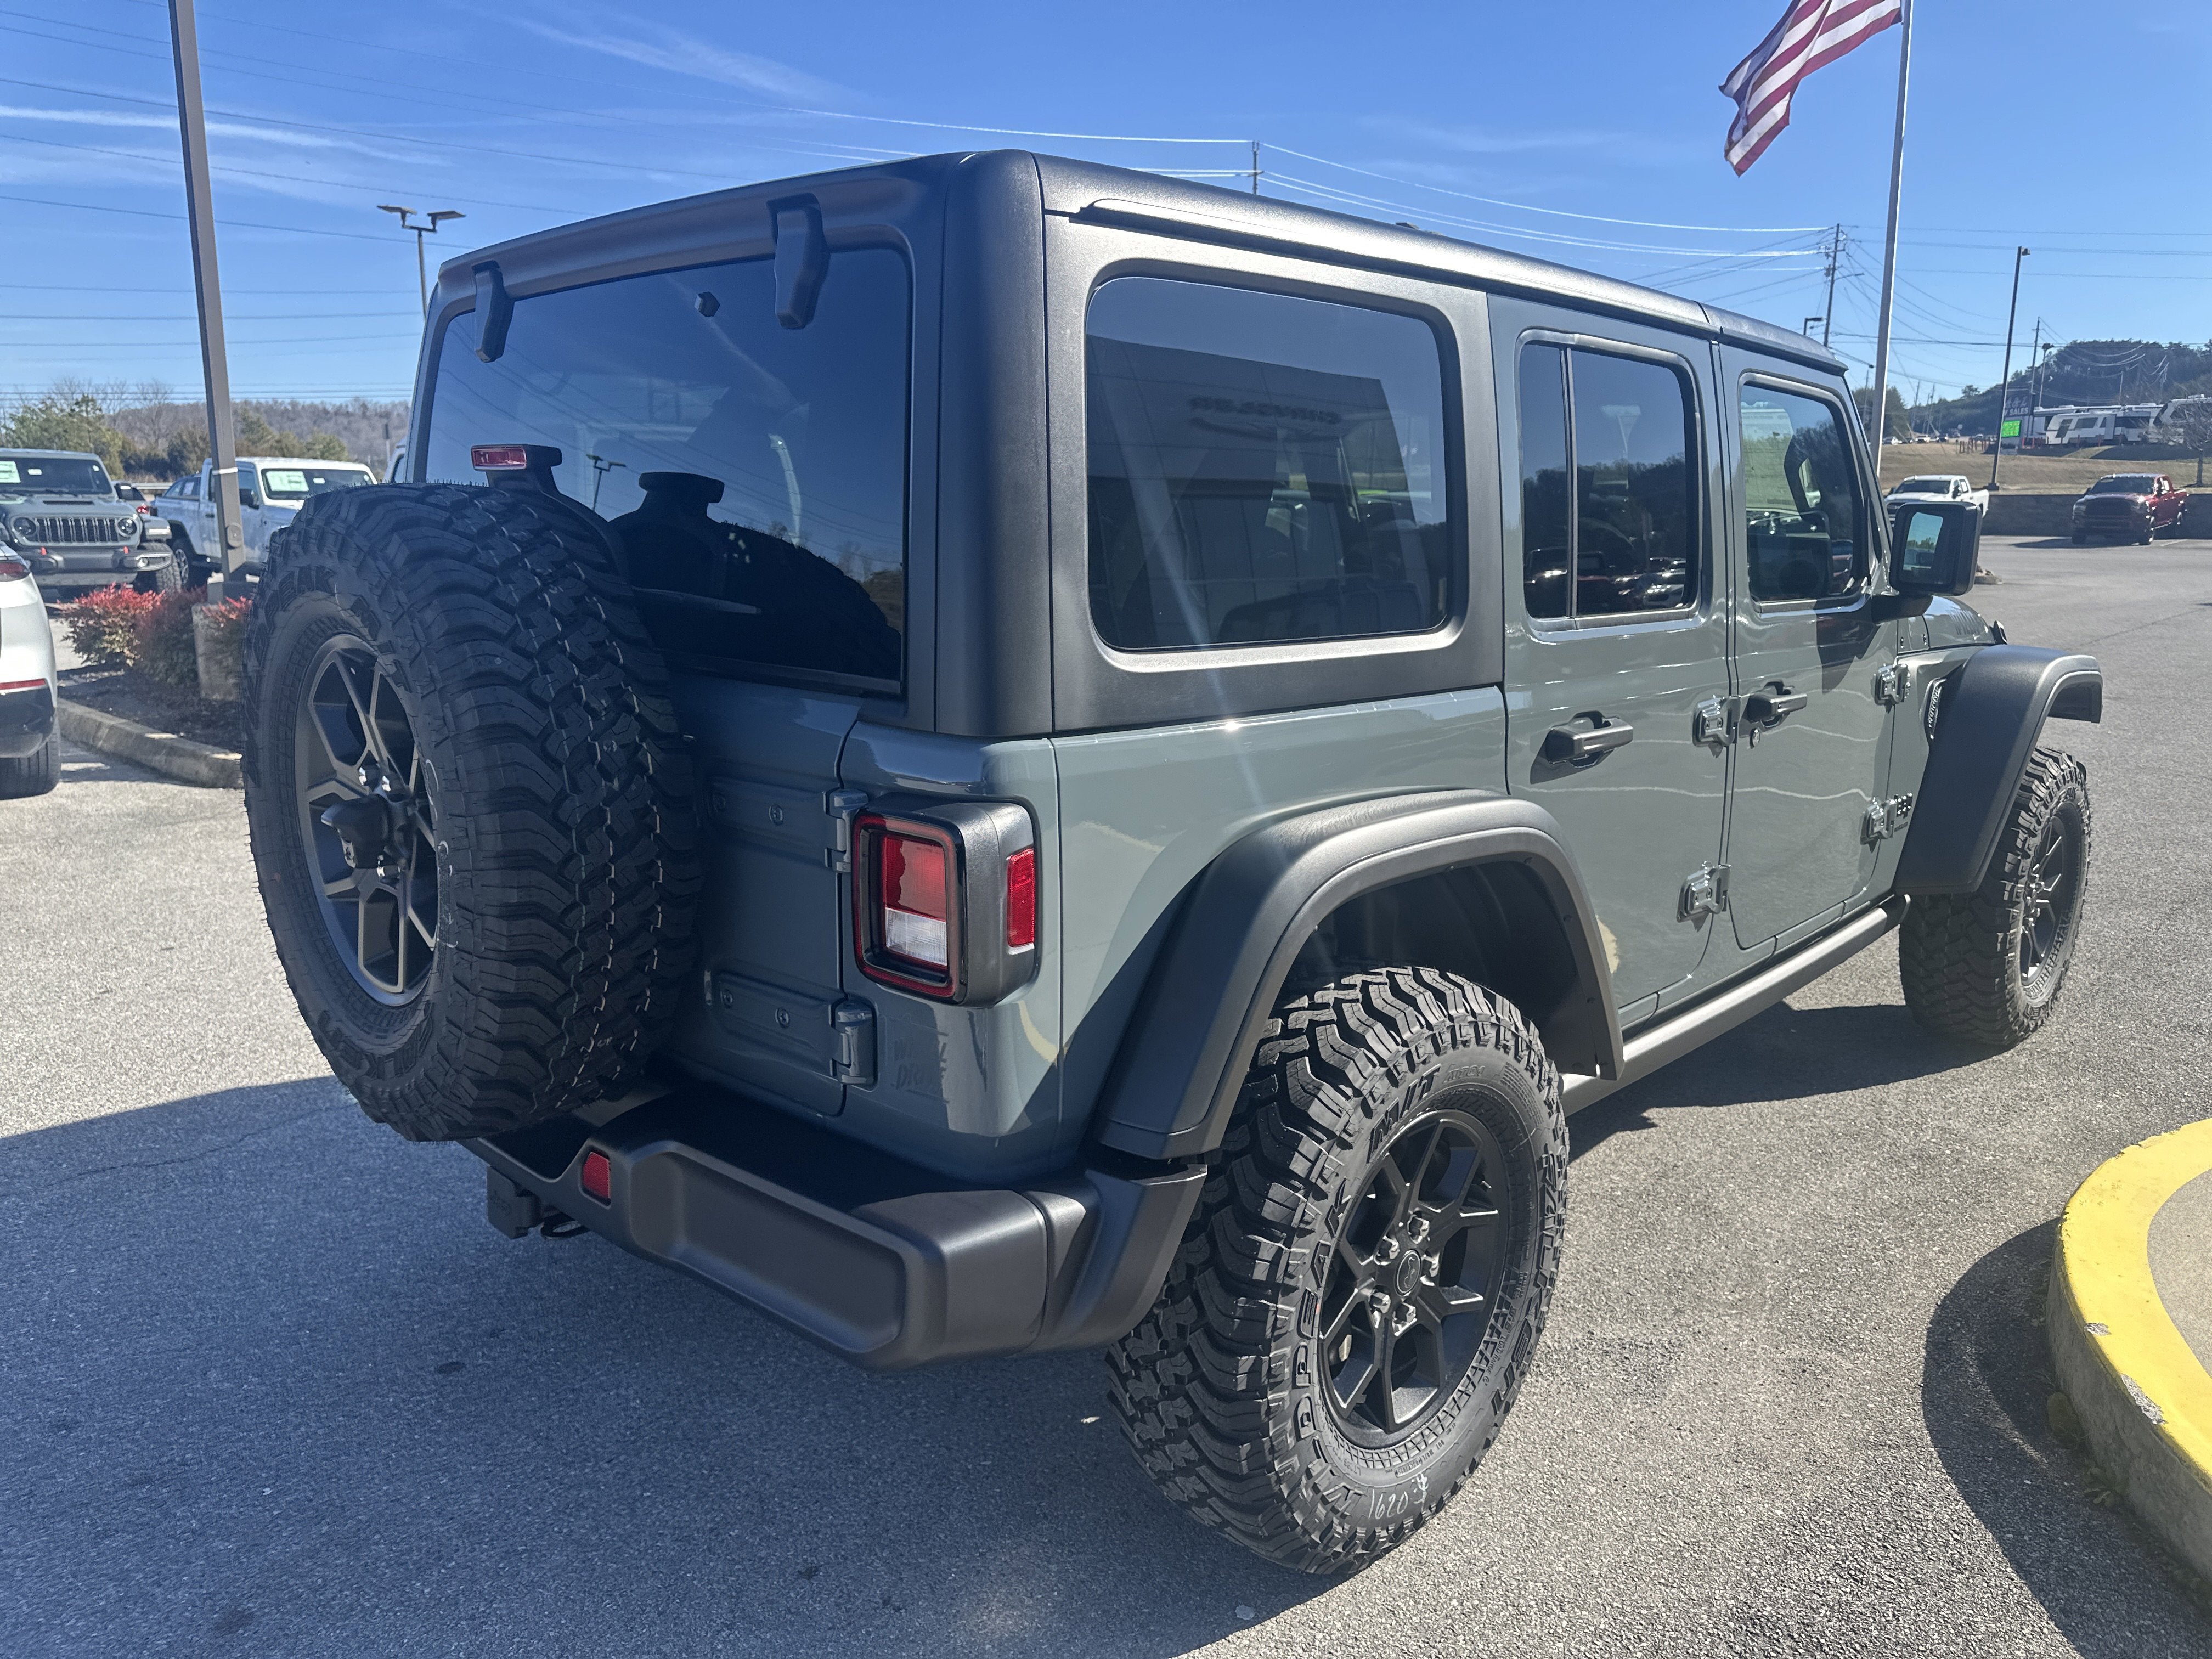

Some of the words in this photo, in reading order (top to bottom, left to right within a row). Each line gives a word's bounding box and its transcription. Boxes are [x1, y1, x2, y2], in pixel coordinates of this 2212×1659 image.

[2010, 407, 2028, 416] SALES
[1291, 1176, 1367, 1521] WILDPEAK
[1490, 1143, 1559, 1417] FALKEN
